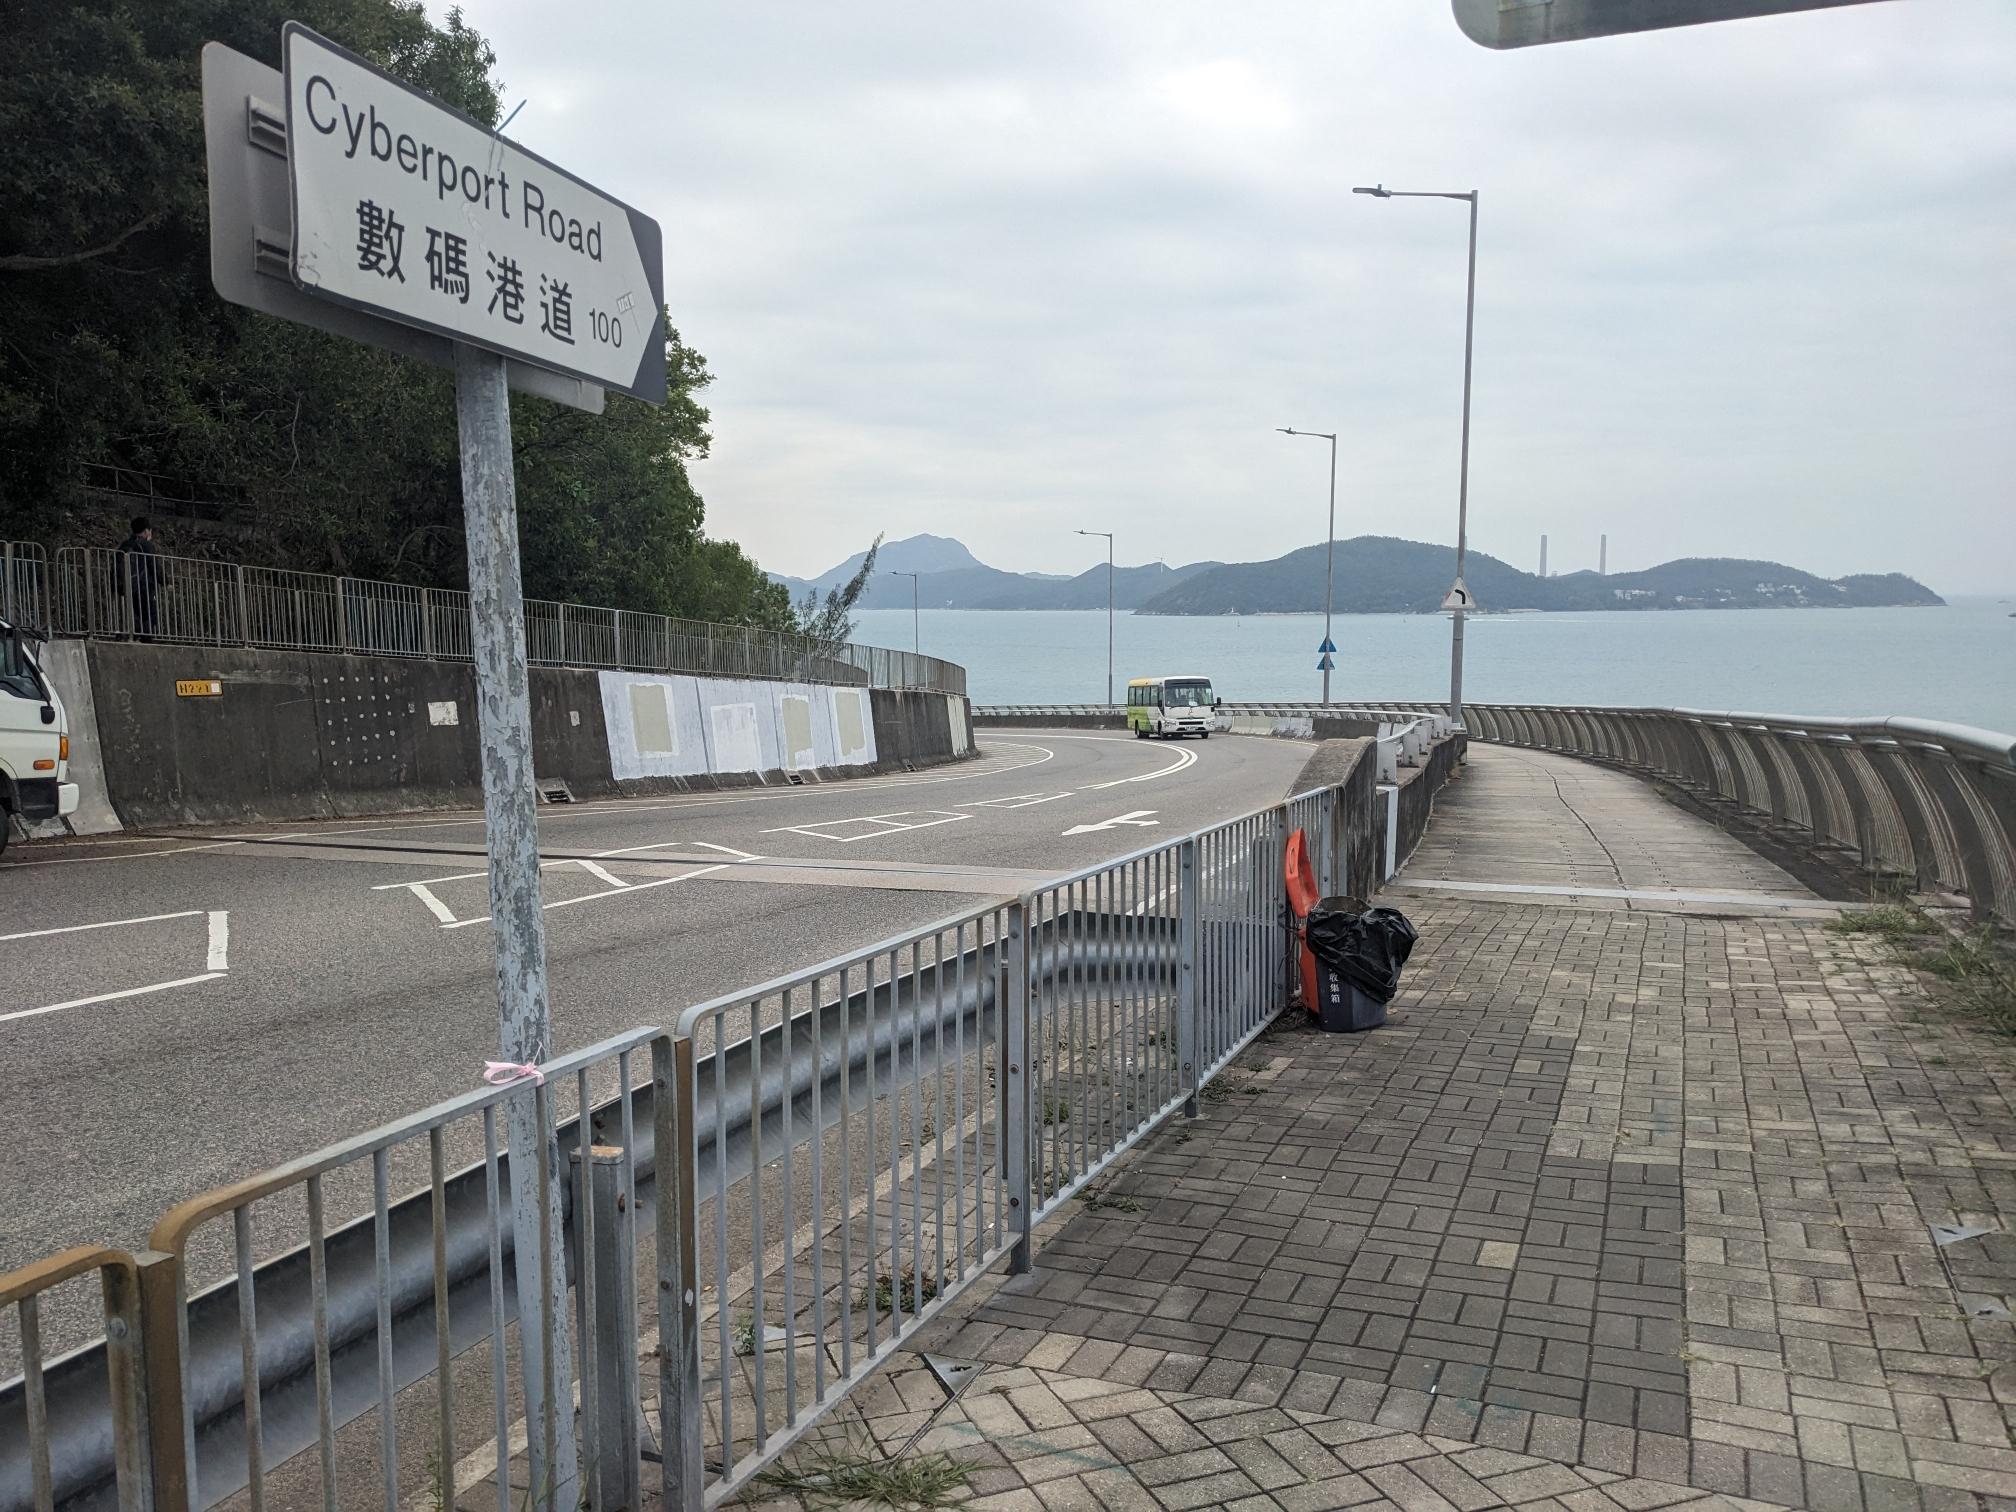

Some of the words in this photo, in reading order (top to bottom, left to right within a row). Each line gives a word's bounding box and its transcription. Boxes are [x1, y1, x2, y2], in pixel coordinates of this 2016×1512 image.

[305, 75, 511, 220] Cyberport
[523, 180, 603, 263] Road
[356, 199, 576, 346] 數碼港道
[588, 307, 622, 349] 100
